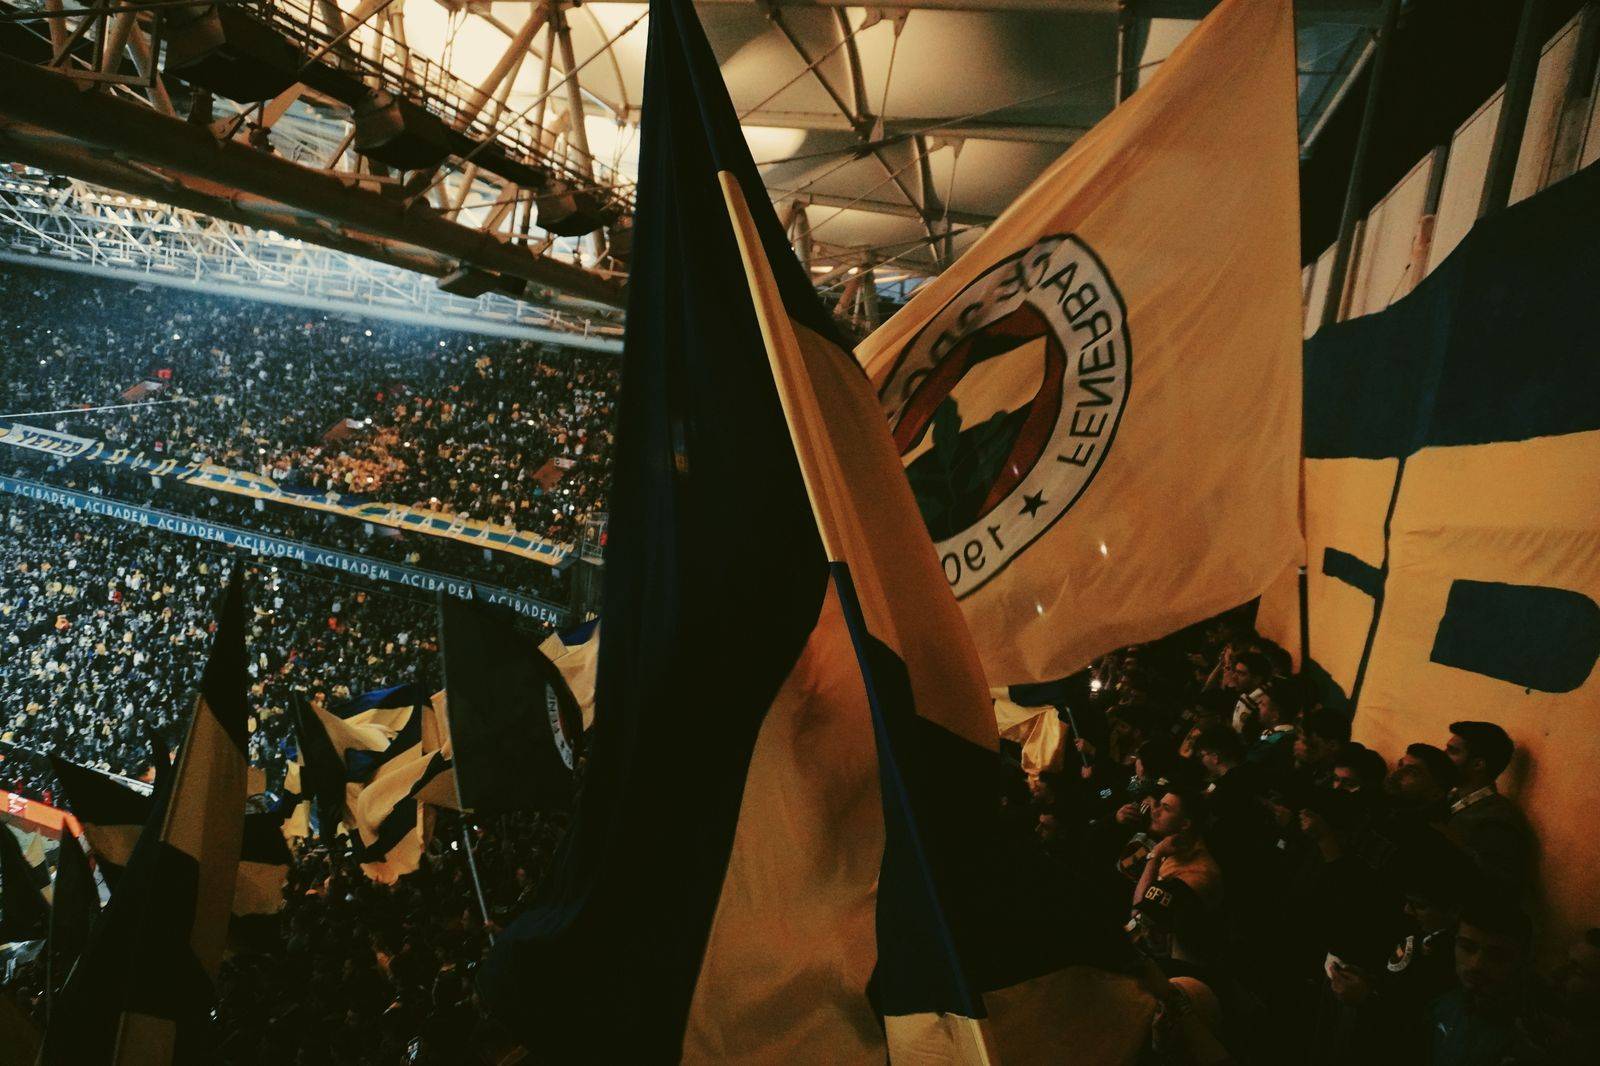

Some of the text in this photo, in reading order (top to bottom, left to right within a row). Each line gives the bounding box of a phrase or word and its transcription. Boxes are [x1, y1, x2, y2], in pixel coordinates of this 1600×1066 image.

[14, 485, 76, 507] ACIBADEM
[84, 501, 148, 524] ACIBADEM
[158, 518, 225, 541] ACIBADEM
[234, 535, 305, 561] ACIBADEM
[315, 553, 390, 580] ACIBADEM
